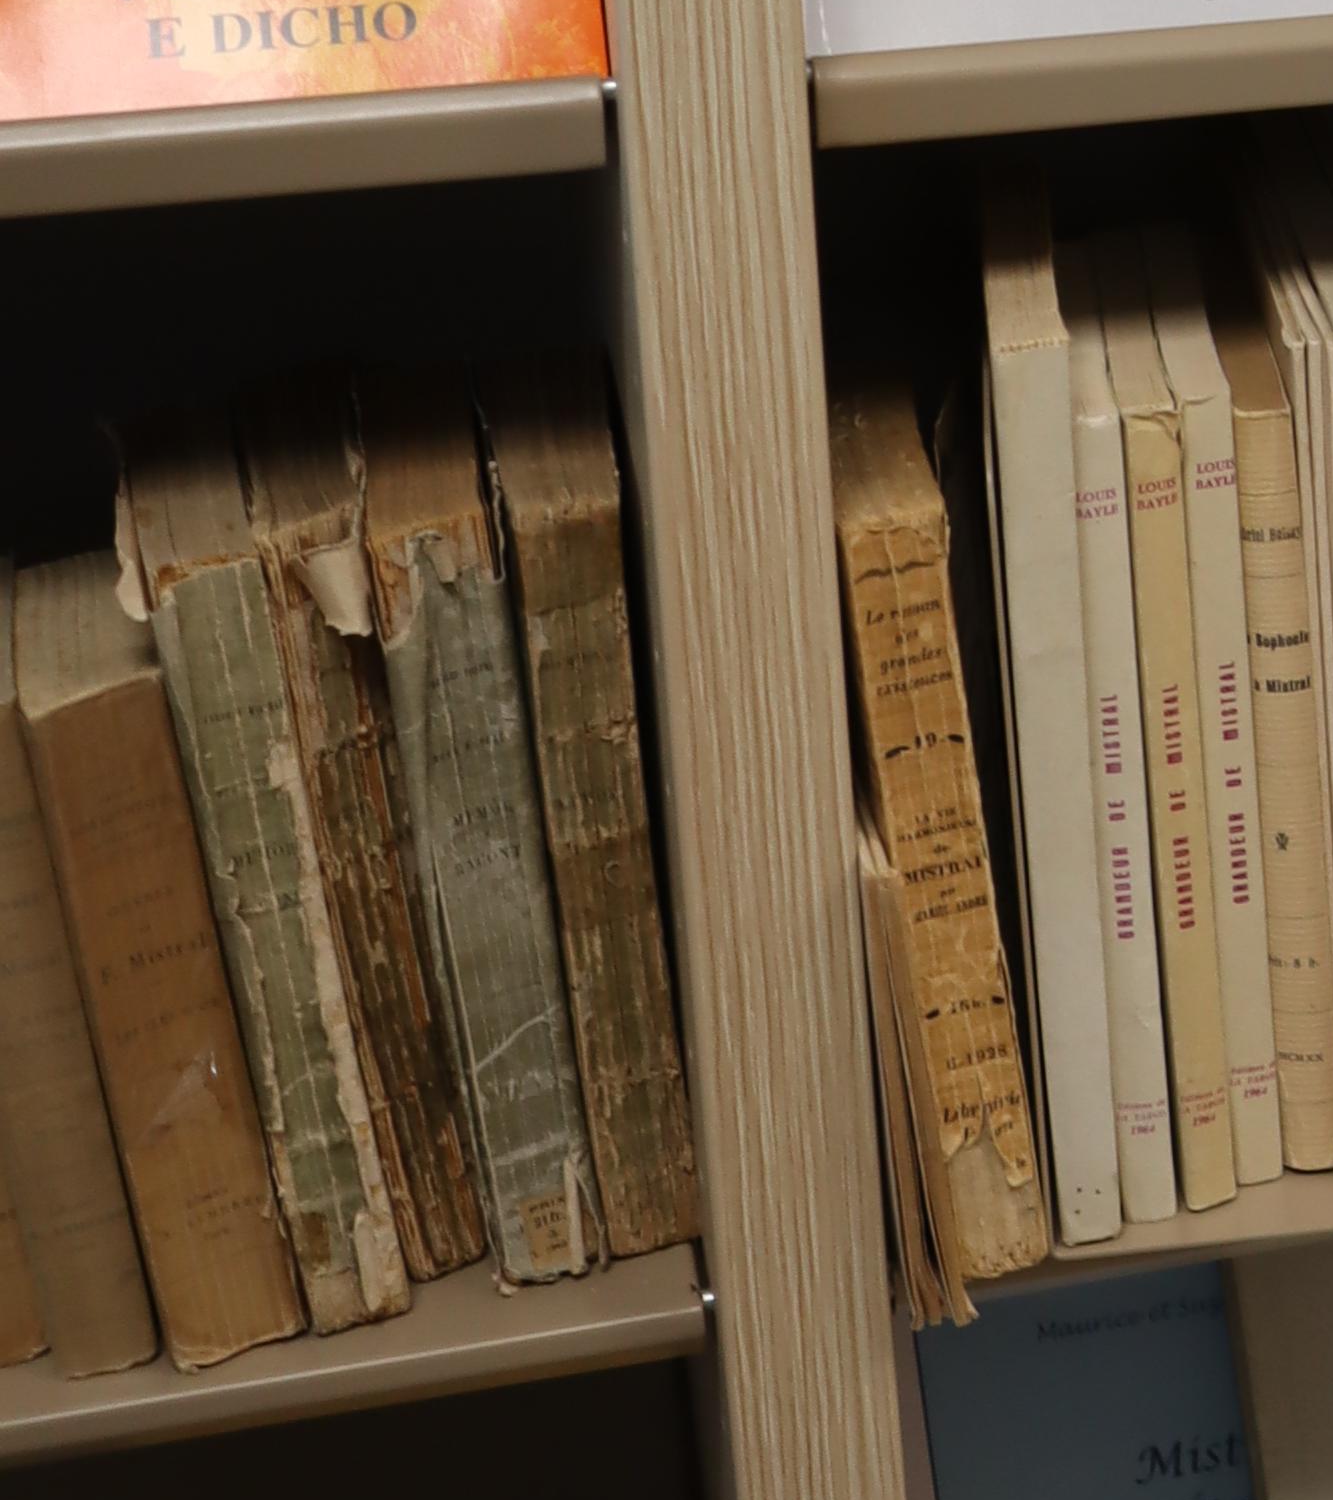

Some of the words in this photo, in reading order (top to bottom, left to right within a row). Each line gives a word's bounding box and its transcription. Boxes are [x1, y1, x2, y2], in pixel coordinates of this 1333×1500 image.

[146, 14, 186, 61] E
[211, 3, 419, 56] DICHO
[1136, 492, 1179, 511] BAYLE
[1137, 477, 1177, 496] LOUIS
[1162, 683, 1183, 765] MISTRAL
[1169, 788, 1186, 812] DE
[1173, 835, 1195, 930] GRANDEUR
